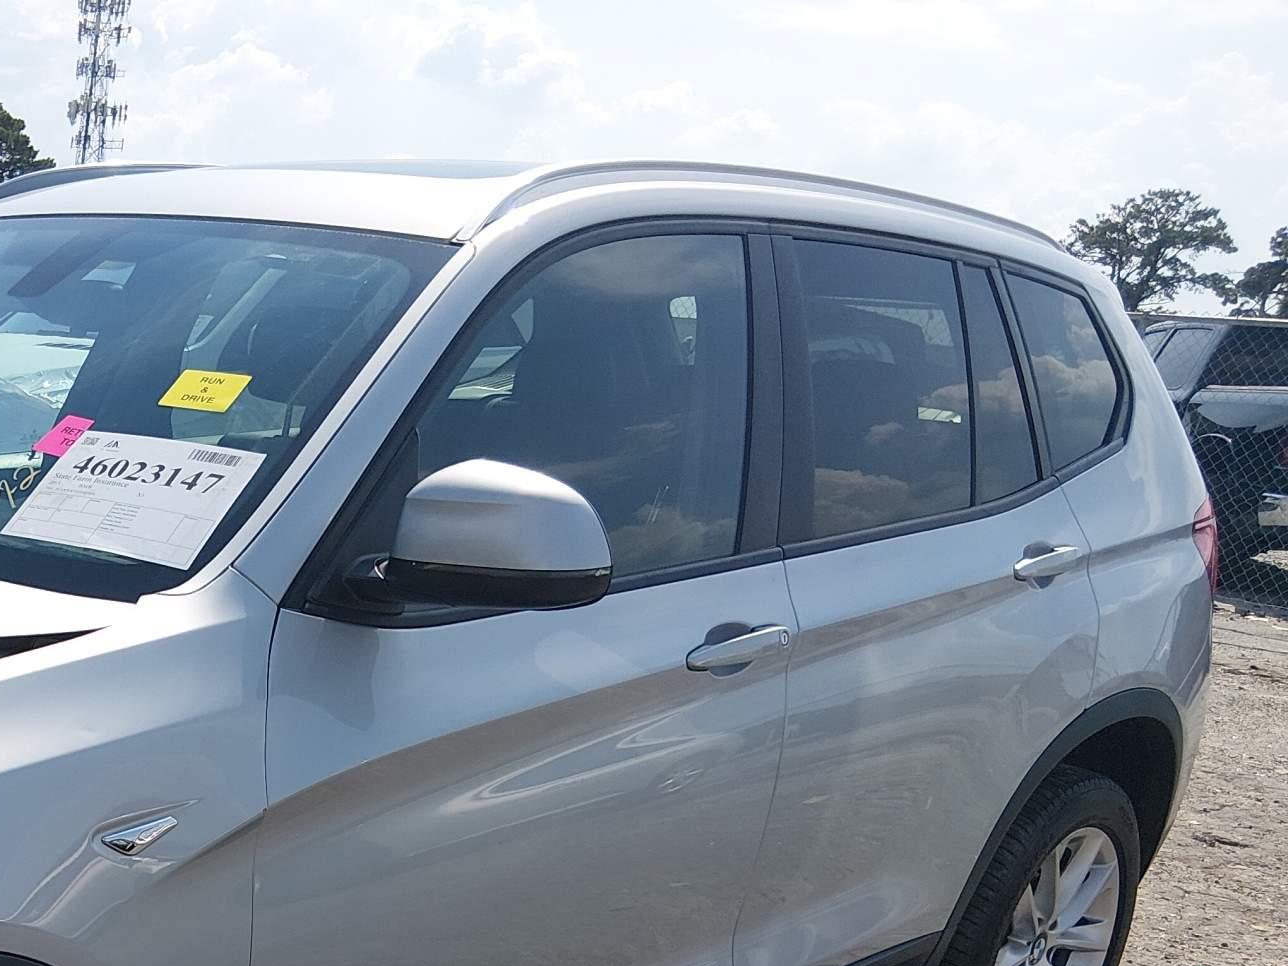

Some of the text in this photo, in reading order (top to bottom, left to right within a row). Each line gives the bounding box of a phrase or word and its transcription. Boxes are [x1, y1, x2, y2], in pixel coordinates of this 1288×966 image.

[199, 376, 226, 385] RUN
[200, 386, 209, 394] &
[180, 394, 216, 404] DRIVE
[73, 455, 226, 494] 46023147
